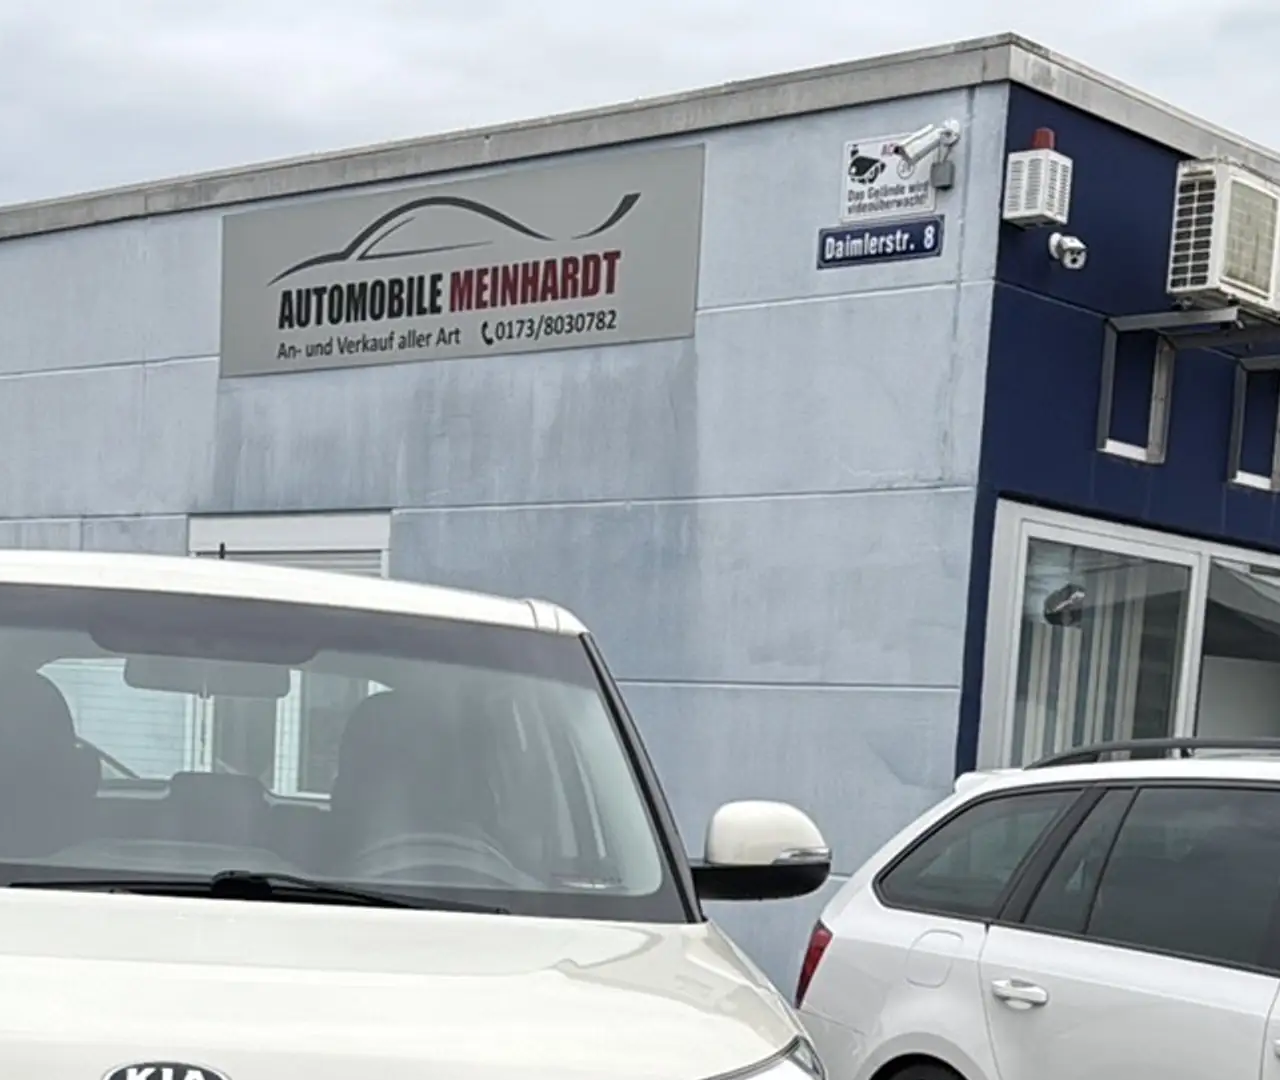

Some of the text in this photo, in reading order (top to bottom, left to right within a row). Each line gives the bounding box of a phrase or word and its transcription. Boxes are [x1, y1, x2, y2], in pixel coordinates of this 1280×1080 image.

[824, 225, 935, 260] Daimlerstr. 8
[278, 250, 622, 330] AUTOMOBILE MEINHARDT
[277, 310, 617, 360] An- und Verkauf aller Art 0173/8030782
